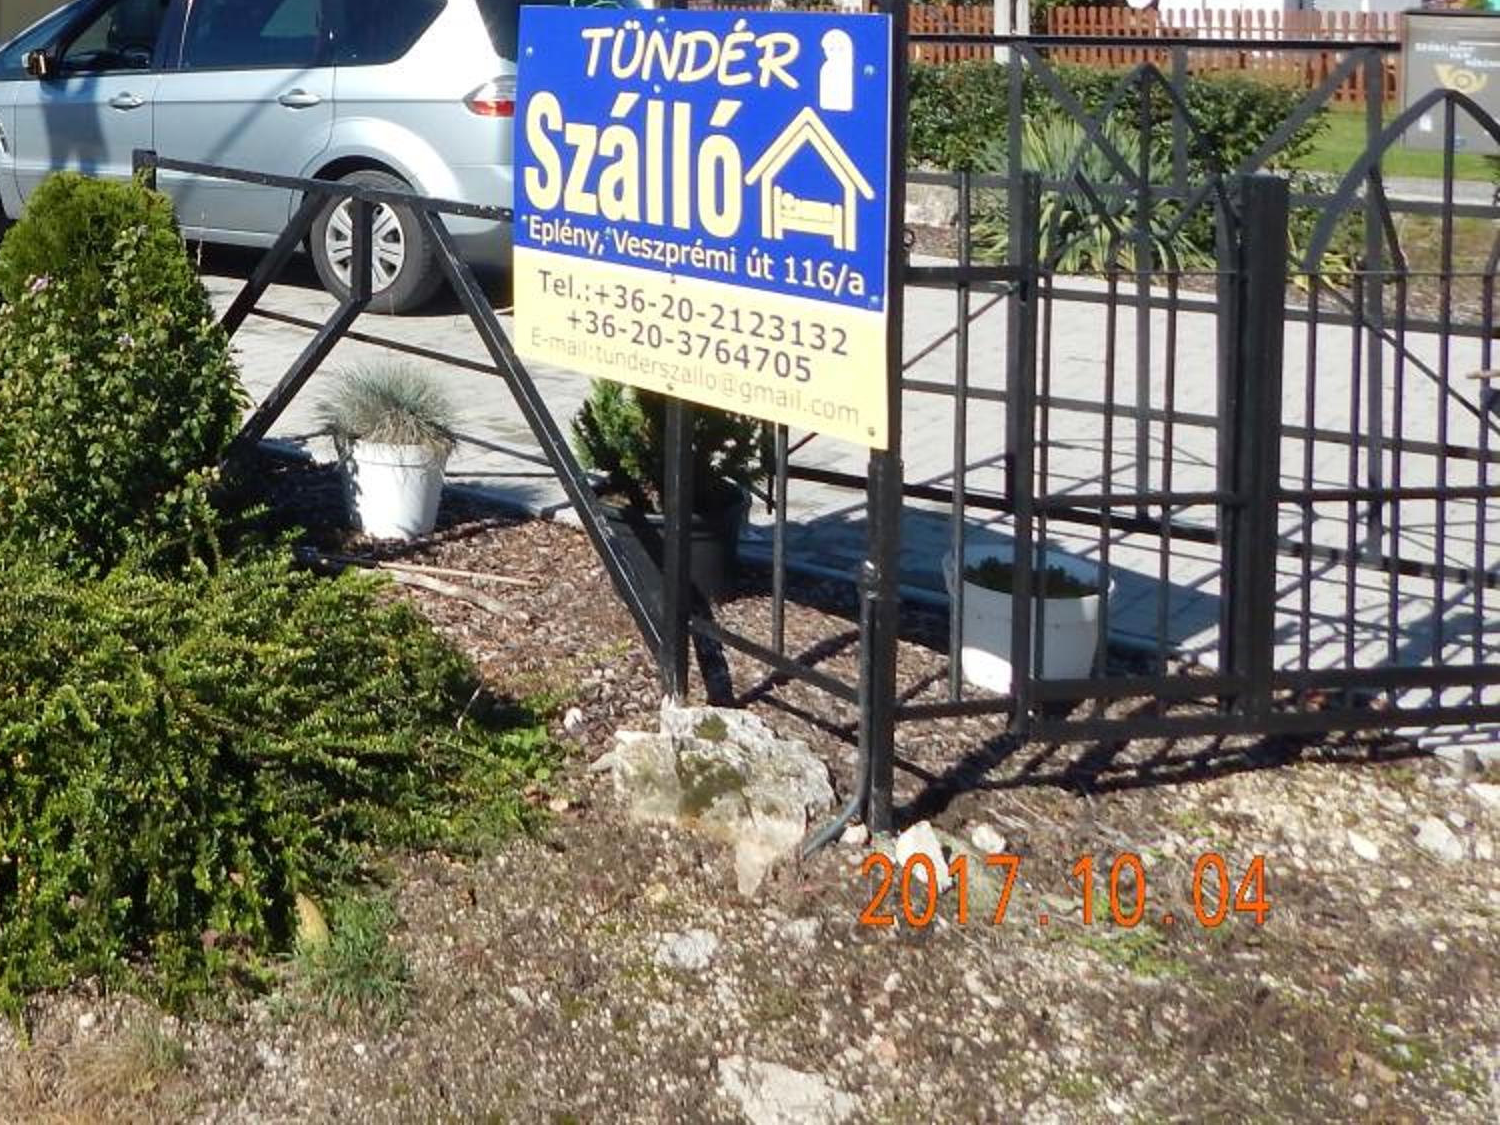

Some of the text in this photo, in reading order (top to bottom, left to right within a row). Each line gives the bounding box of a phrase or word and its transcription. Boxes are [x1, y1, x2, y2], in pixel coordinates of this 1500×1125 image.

[581, 18, 800, 90] TÜNDÉR
[523, 91, 744, 239] Szálló
[529, 215, 866, 296] Eplény, Veszprémi út 116/a
[567, 309, 813, 383] +36-20-3764705
